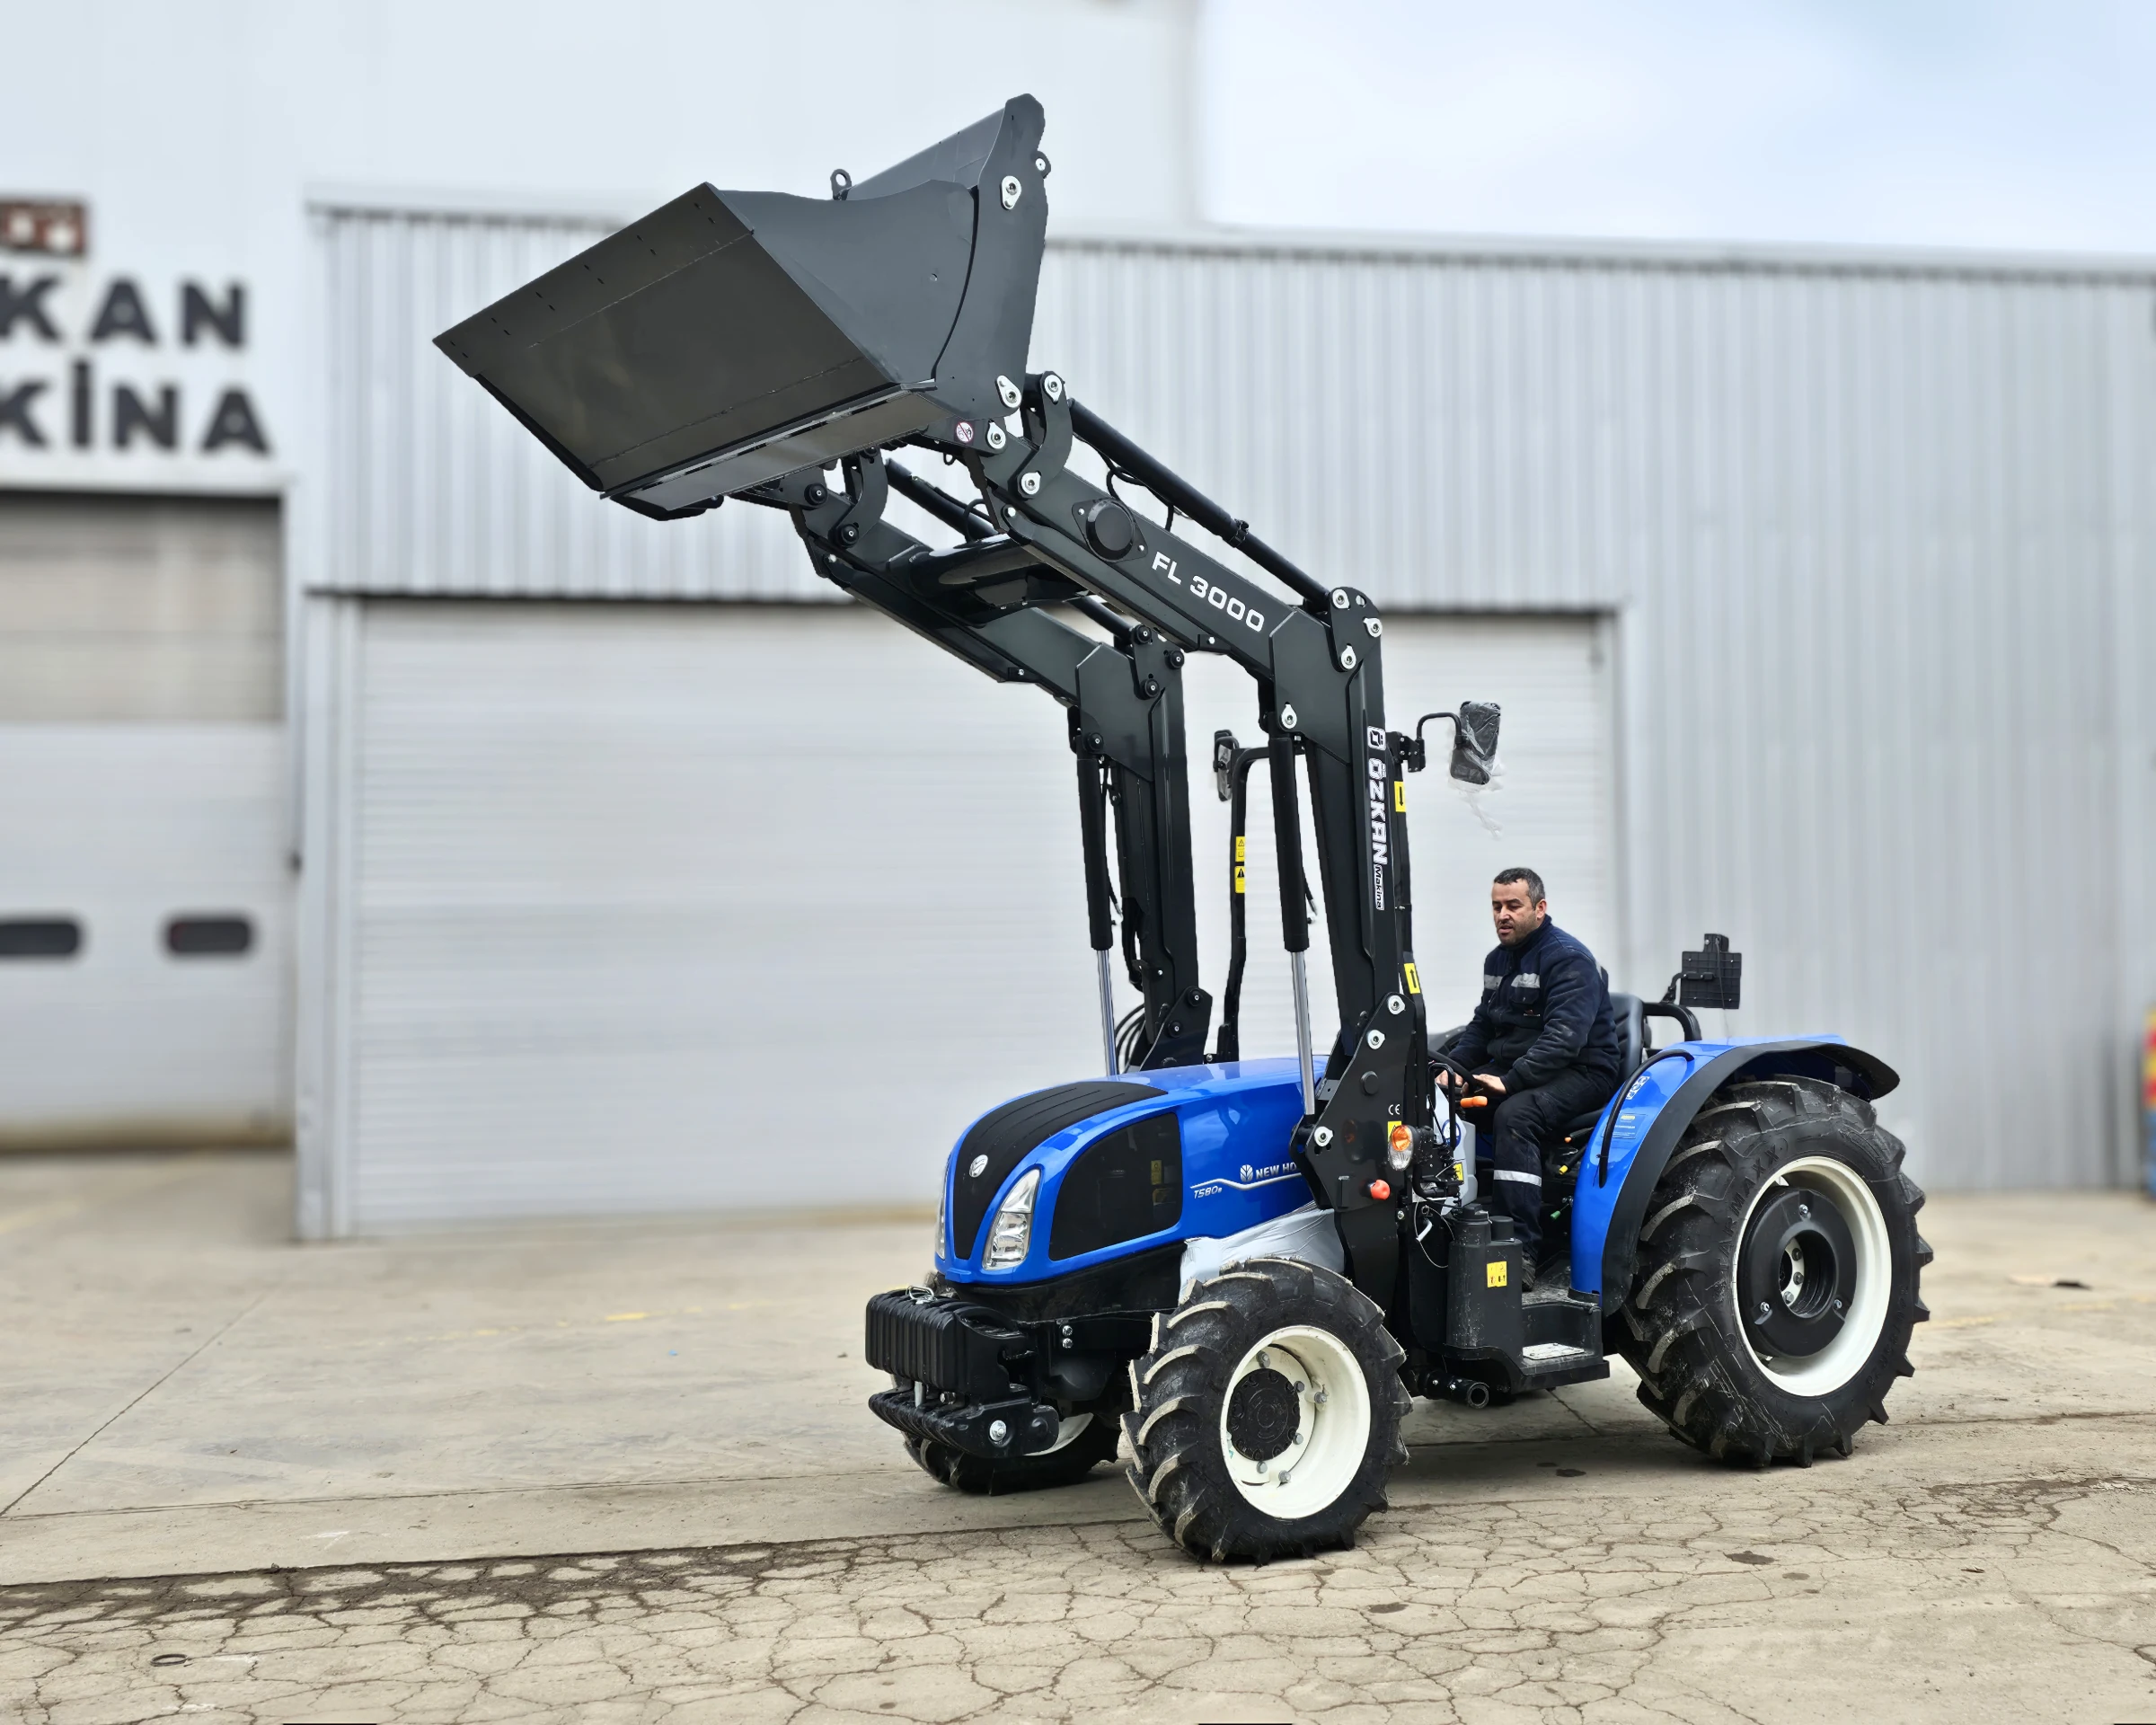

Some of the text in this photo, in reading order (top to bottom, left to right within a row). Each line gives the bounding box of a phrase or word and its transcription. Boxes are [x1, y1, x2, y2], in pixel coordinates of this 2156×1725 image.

[0, 273, 246, 349] KAN
[1152, 551, 1265, 632] FL 3000
[1368, 758, 1388, 865] ÖZKAN
[1374, 865, 1383, 908] Makina
[1256, 1164, 1280, 1180] NEW
